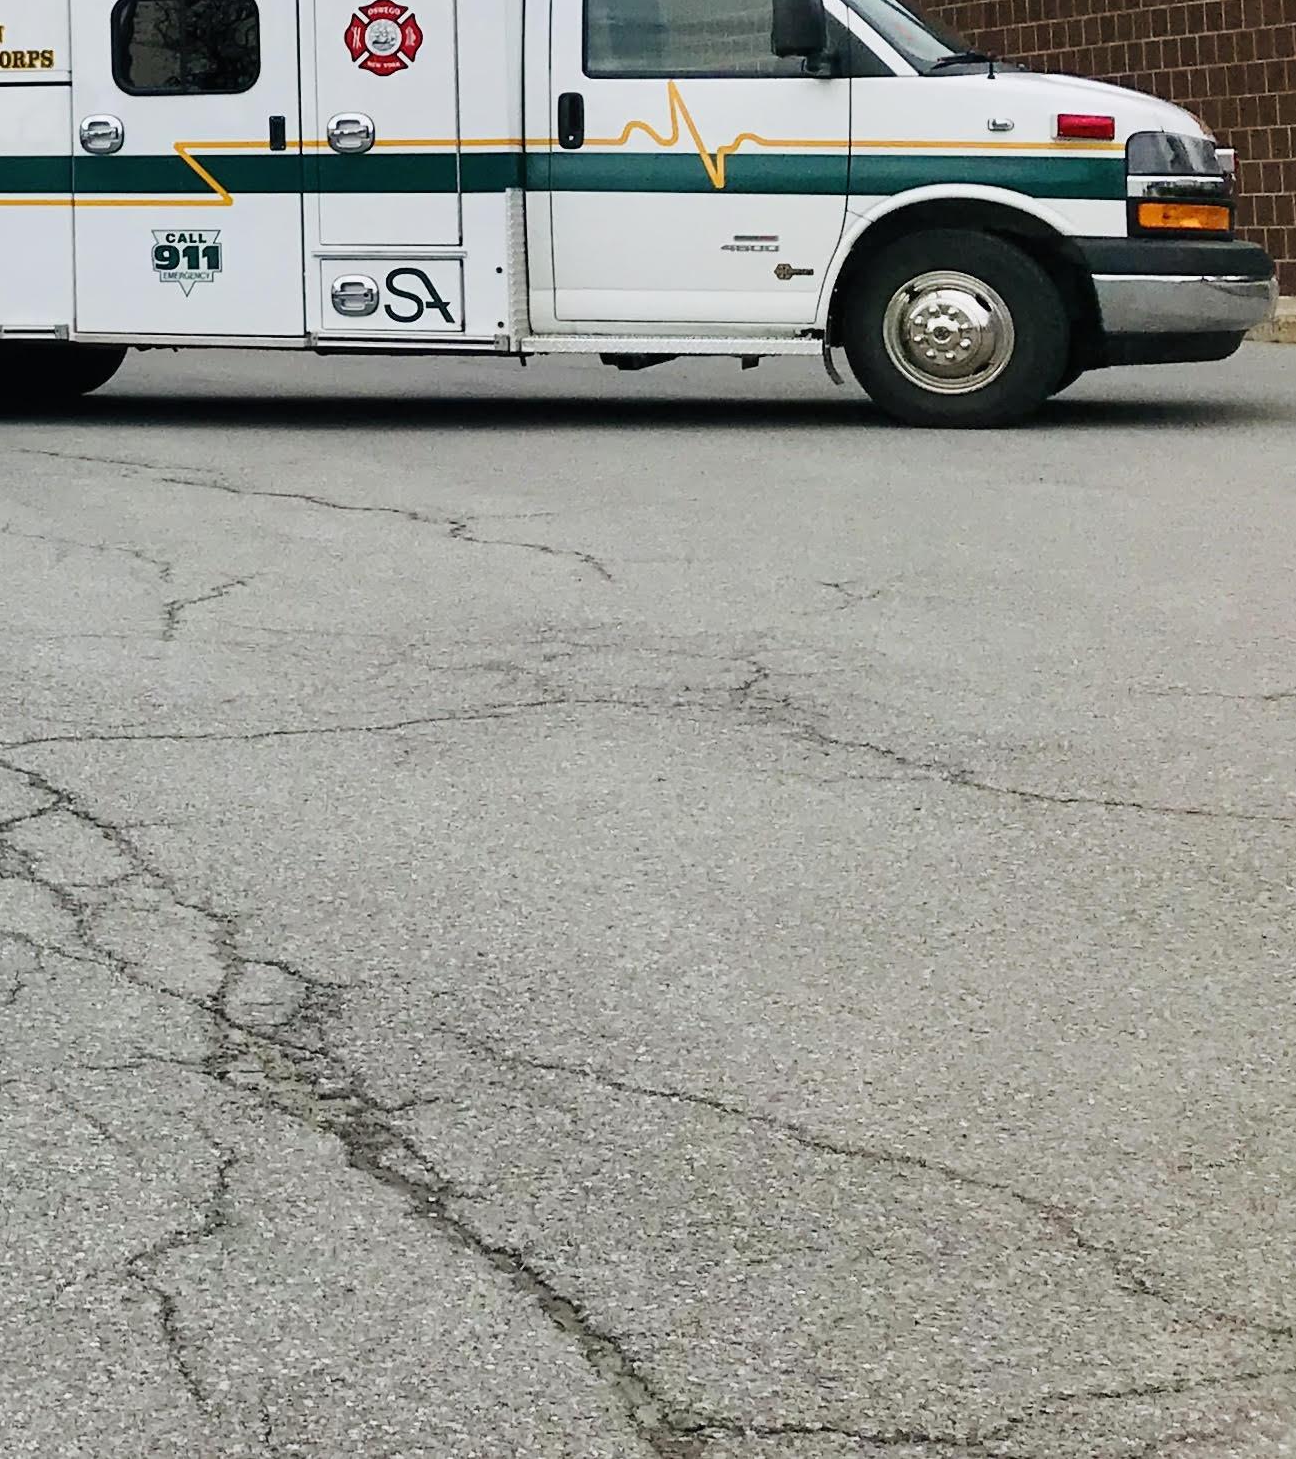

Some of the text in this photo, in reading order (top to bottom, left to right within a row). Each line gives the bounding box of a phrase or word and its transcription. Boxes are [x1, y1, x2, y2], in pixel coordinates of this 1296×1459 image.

[367, 6, 401, 16] OSWEGO
[165, 233, 207, 244] CALL
[154, 244, 220, 270] 911
[163, 271, 210, 280] EMERGENCY
